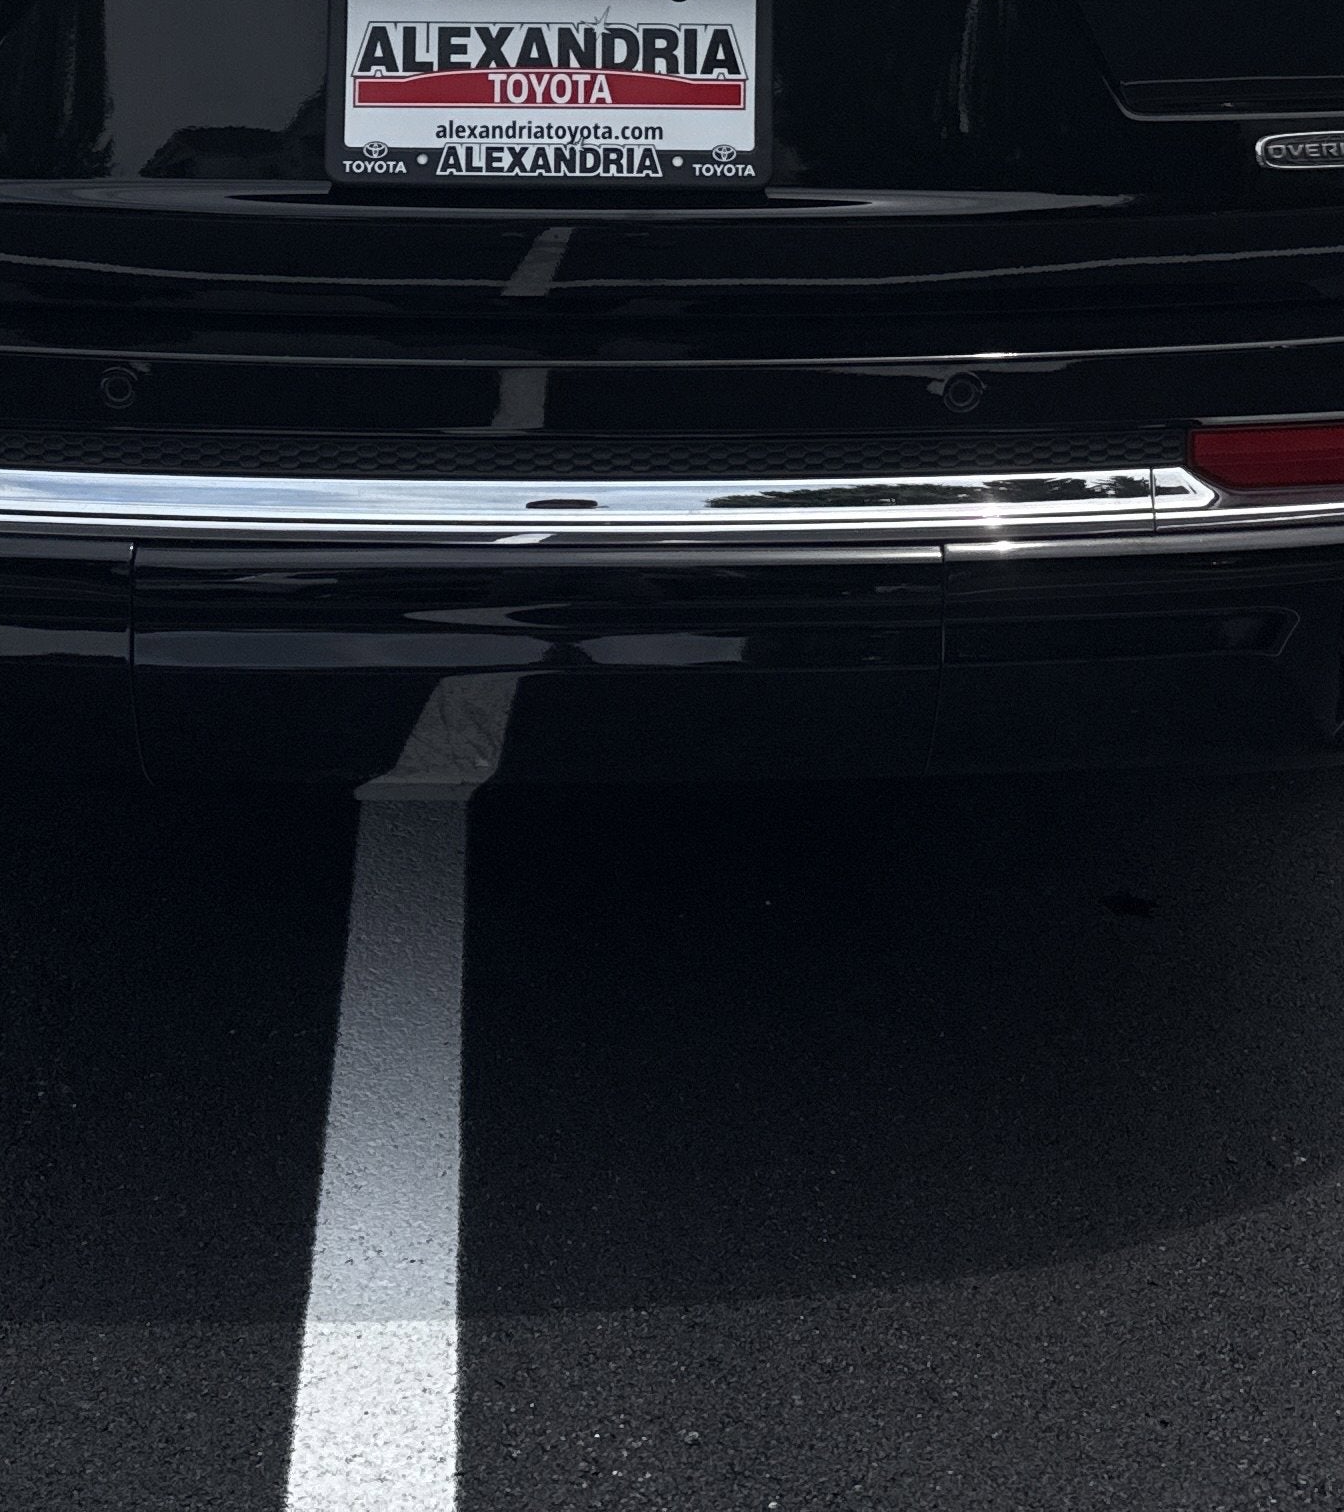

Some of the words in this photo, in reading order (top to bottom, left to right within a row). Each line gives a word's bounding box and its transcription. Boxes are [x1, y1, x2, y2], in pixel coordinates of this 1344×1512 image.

[358, 26, 741, 76] ALEXANDRIA
[488, 73, 613, 104] TOYOTA
[435, 120, 664, 143] alexandriatoyota.com
[343, 160, 407, 174] TOYOTA
[437, 145, 663, 177] ALEXANDRIA
[693, 163, 756, 177] TOYOTA
